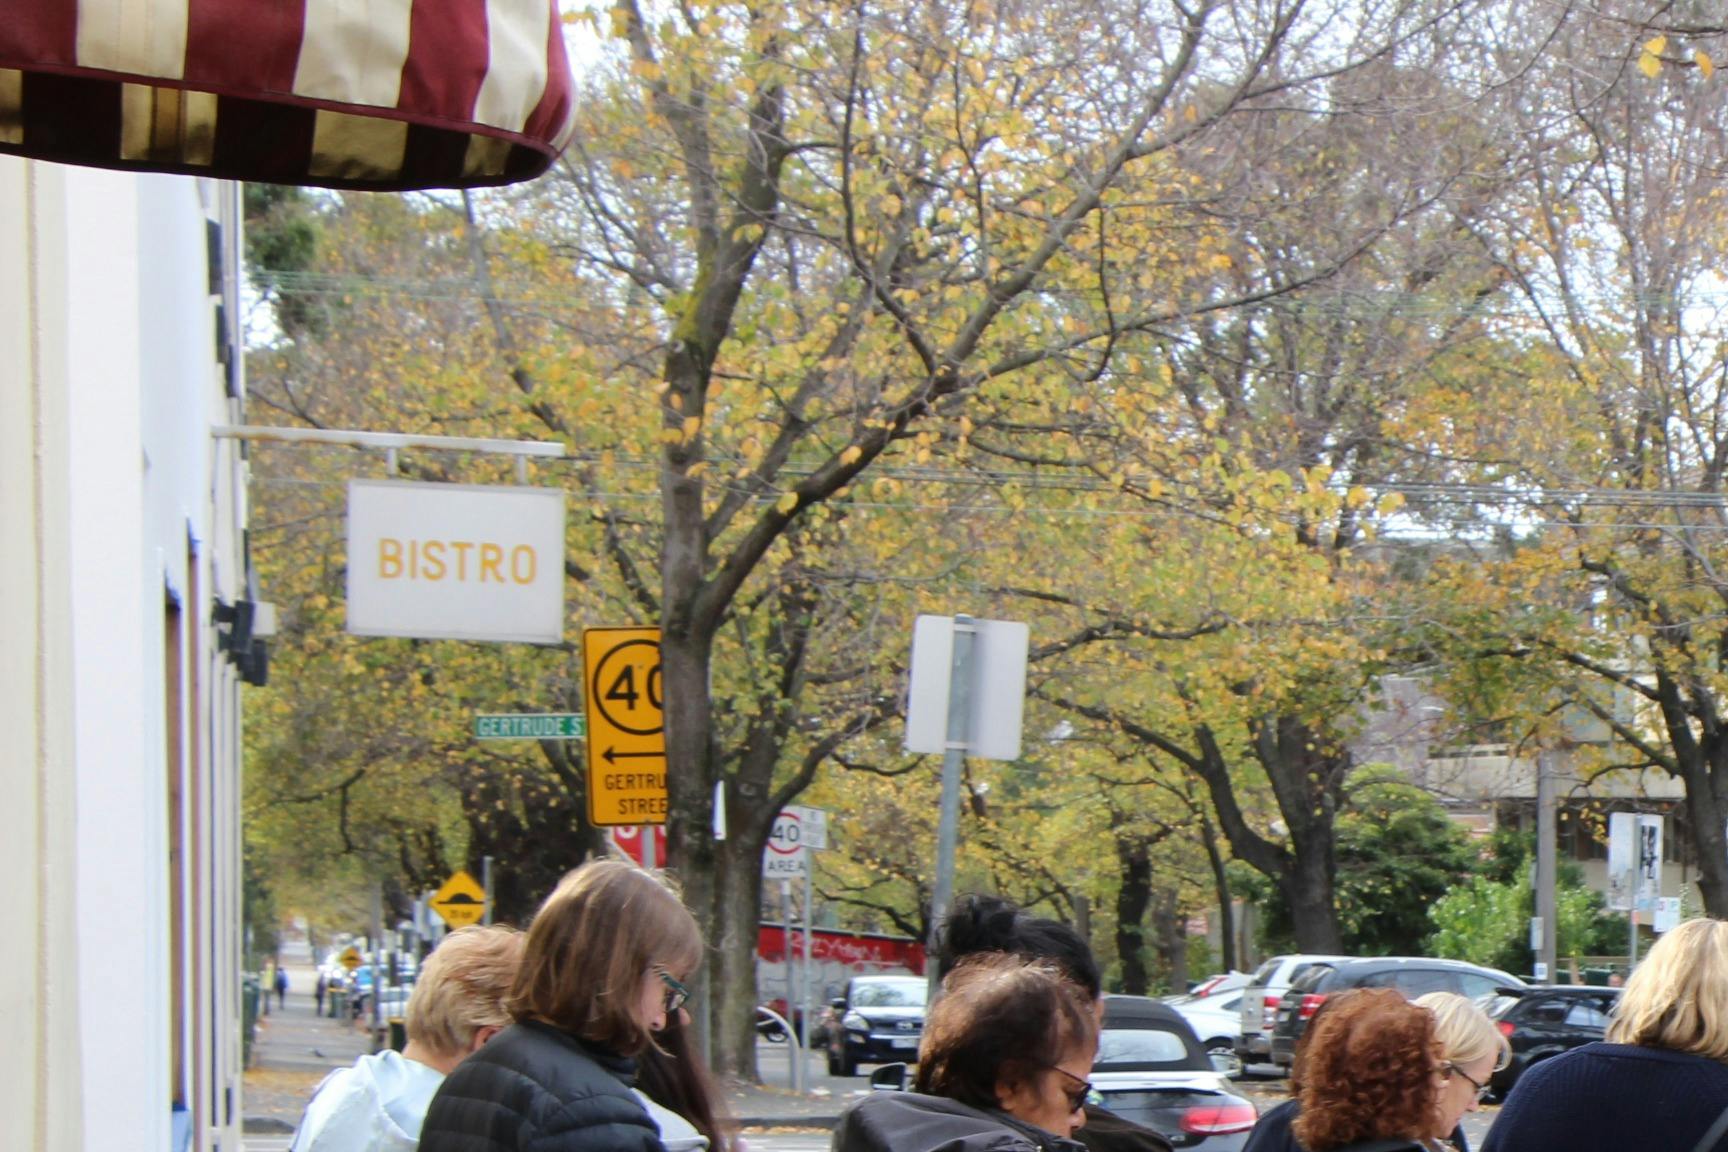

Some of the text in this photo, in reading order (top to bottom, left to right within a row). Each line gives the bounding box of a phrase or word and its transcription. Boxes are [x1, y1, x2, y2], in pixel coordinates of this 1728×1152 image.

[378, 538, 538, 585] BISTRO
[478, 717, 582, 736] GERTRUDE S
[605, 773, 667, 791] GERTRU
[618, 798, 667, 815] STREE
[770, 823, 800, 843] 40
[767, 859, 806, 873] AREA
